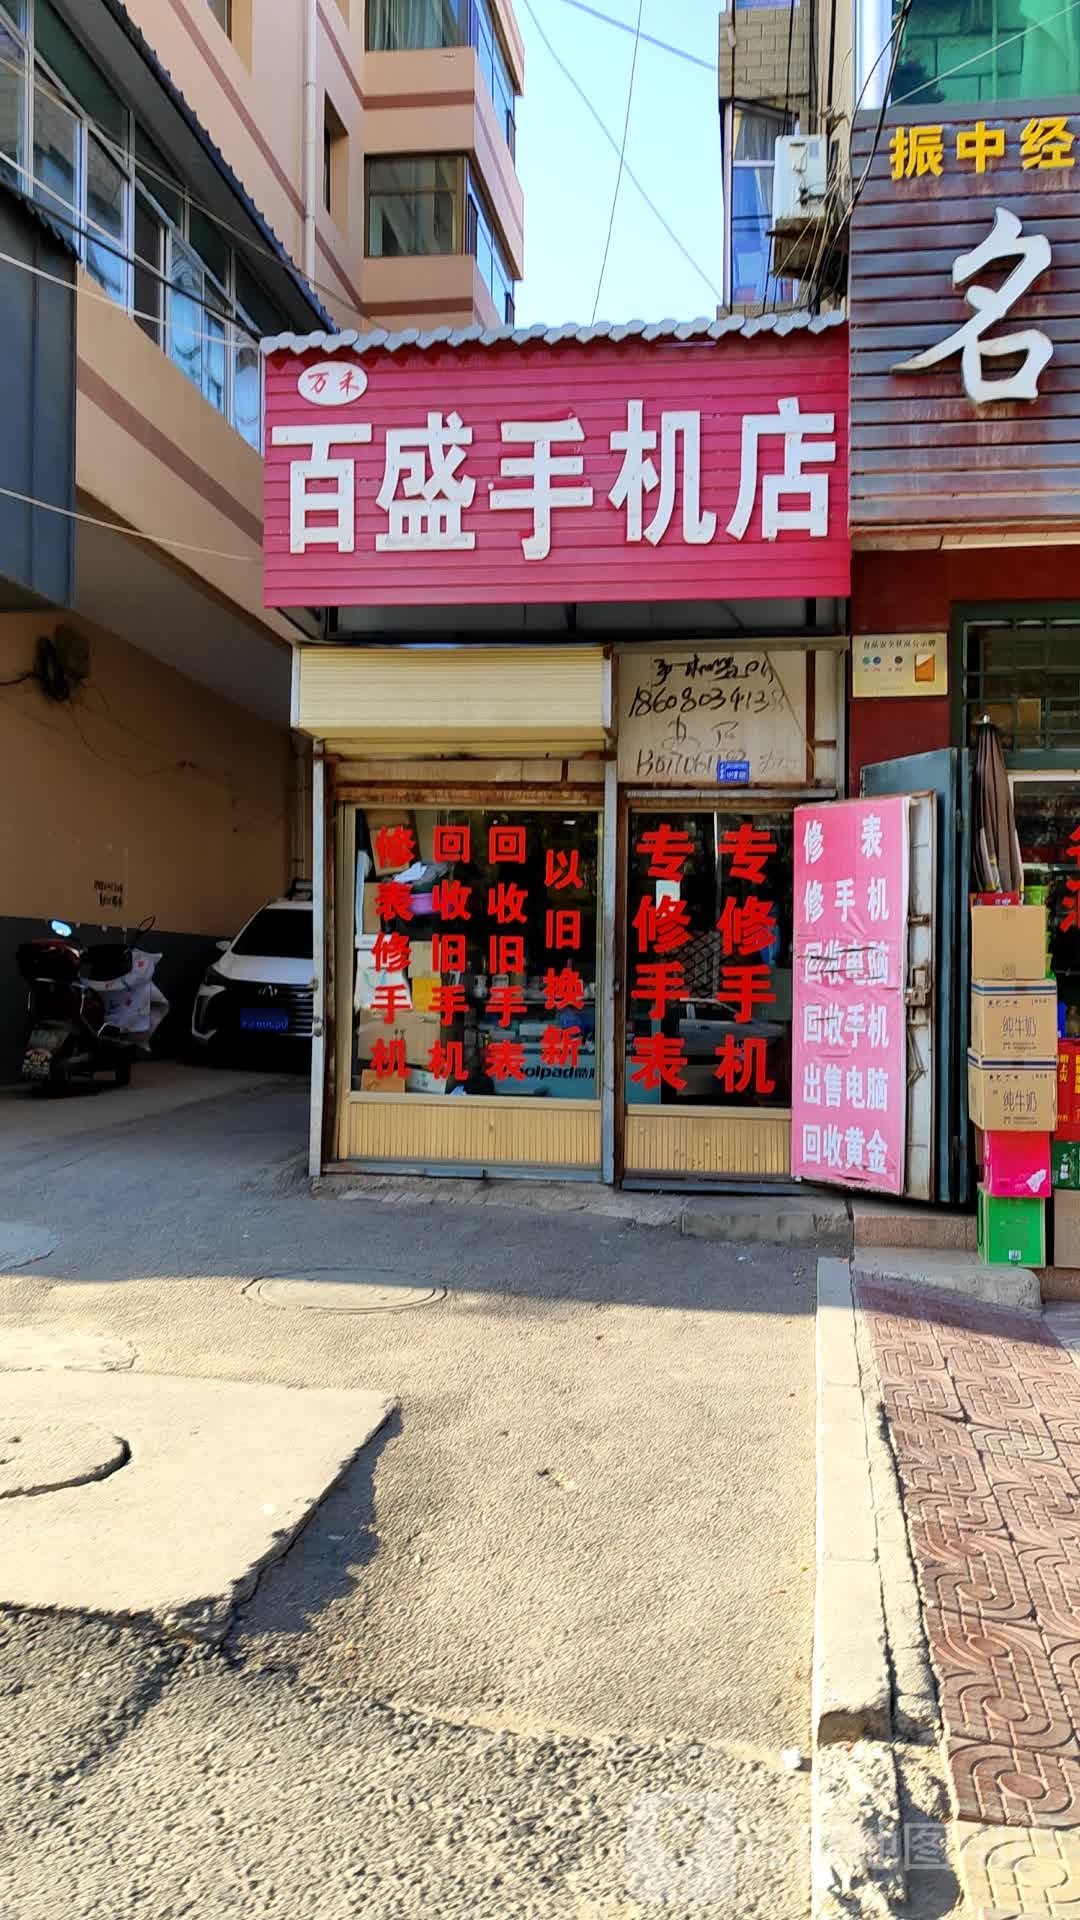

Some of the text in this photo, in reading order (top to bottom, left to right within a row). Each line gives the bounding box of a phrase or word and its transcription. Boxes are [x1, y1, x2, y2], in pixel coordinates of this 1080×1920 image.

[889, 117, 1075, 180] 振中经
[890, 207, 1054, 405] 名
[271, 396, 836, 561] 百盛手机店
[370, 826, 415, 1080] 修表修手机
[427, 825, 472, 1080] 回收旧手机
[485, 826, 528, 1082] 回收旧手表
[541, 849, 585, 1067] 以旧换新
[631, 824, 695, 1091] 专修手表
[715, 824, 778, 1094] 专修手机
[803, 1003, 890, 1049] 回收手机
[1002, 1015, 1037, 1039] 纯牛奶
[802, 1124, 888, 1174] 回收黄金
[803, 1063, 889, 1112] 出售电脑
[1002, 1088, 1038, 1113] 纯牛奶
